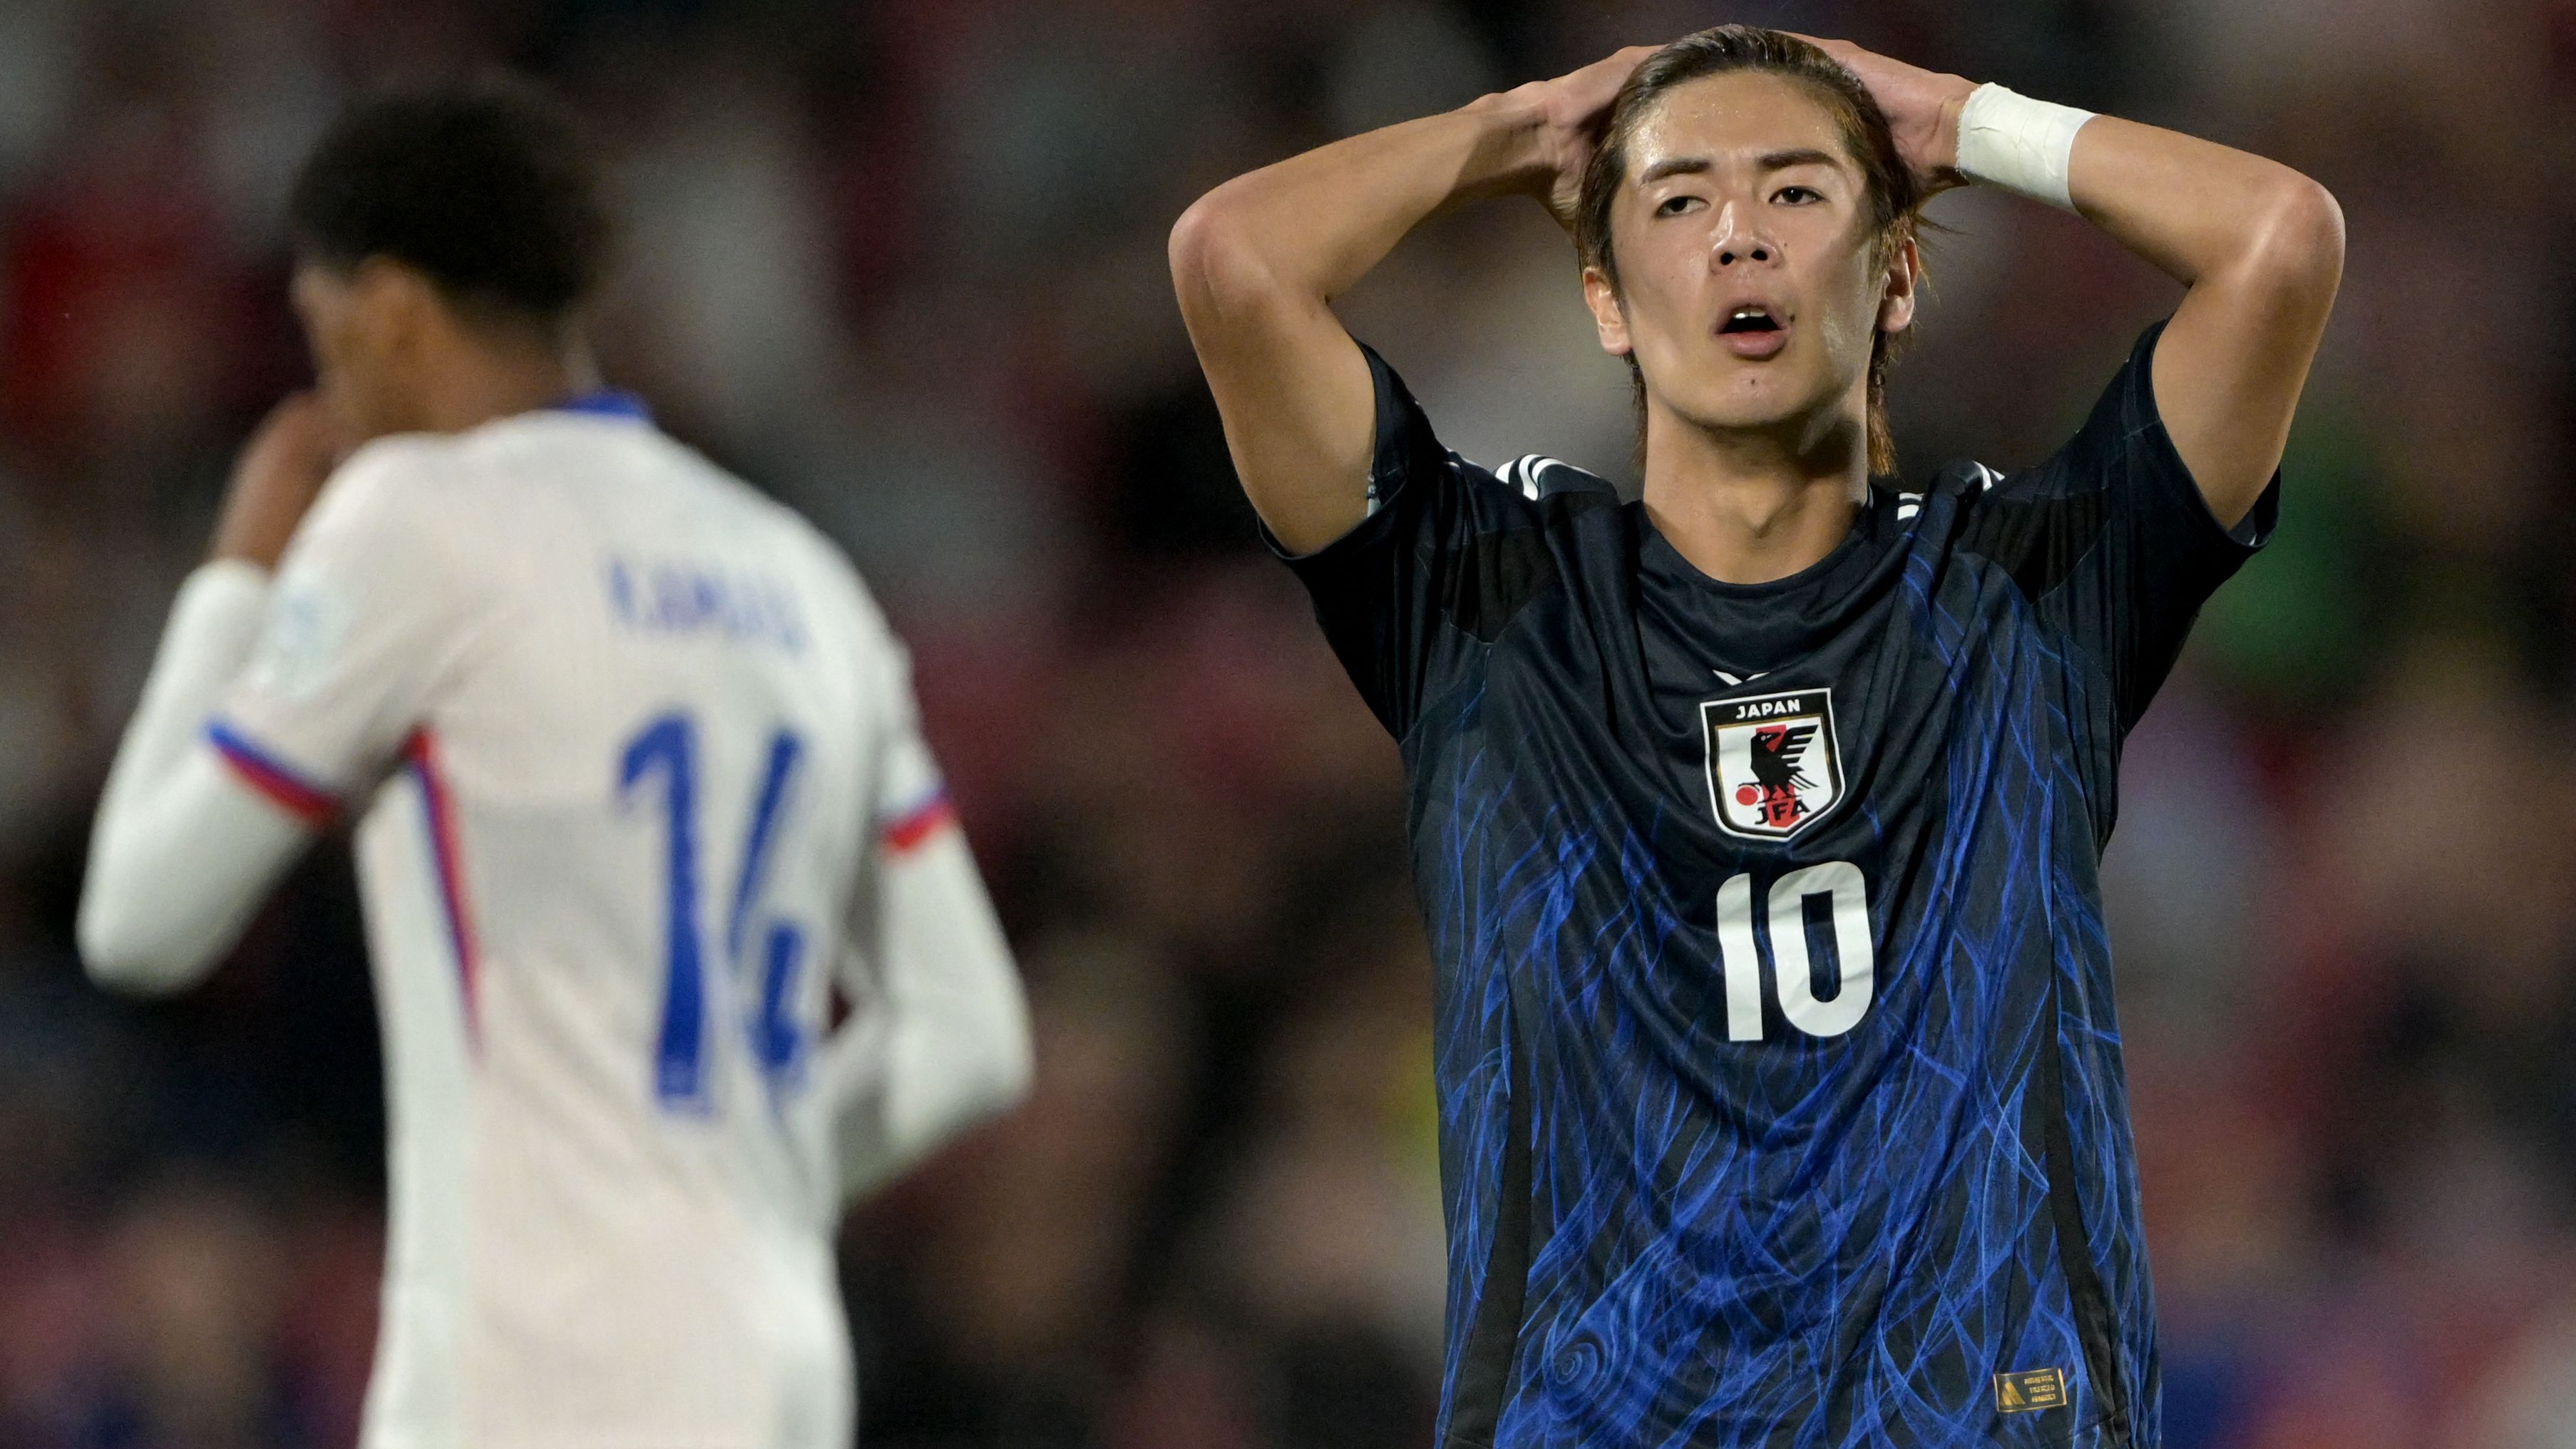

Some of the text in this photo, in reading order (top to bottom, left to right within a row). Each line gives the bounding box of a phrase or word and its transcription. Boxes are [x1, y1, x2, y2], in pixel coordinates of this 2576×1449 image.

[1735, 698, 1801, 720] JAPAN
[1755, 799, 1811, 824] JFA
[1716, 861, 1874, 1042] 10
